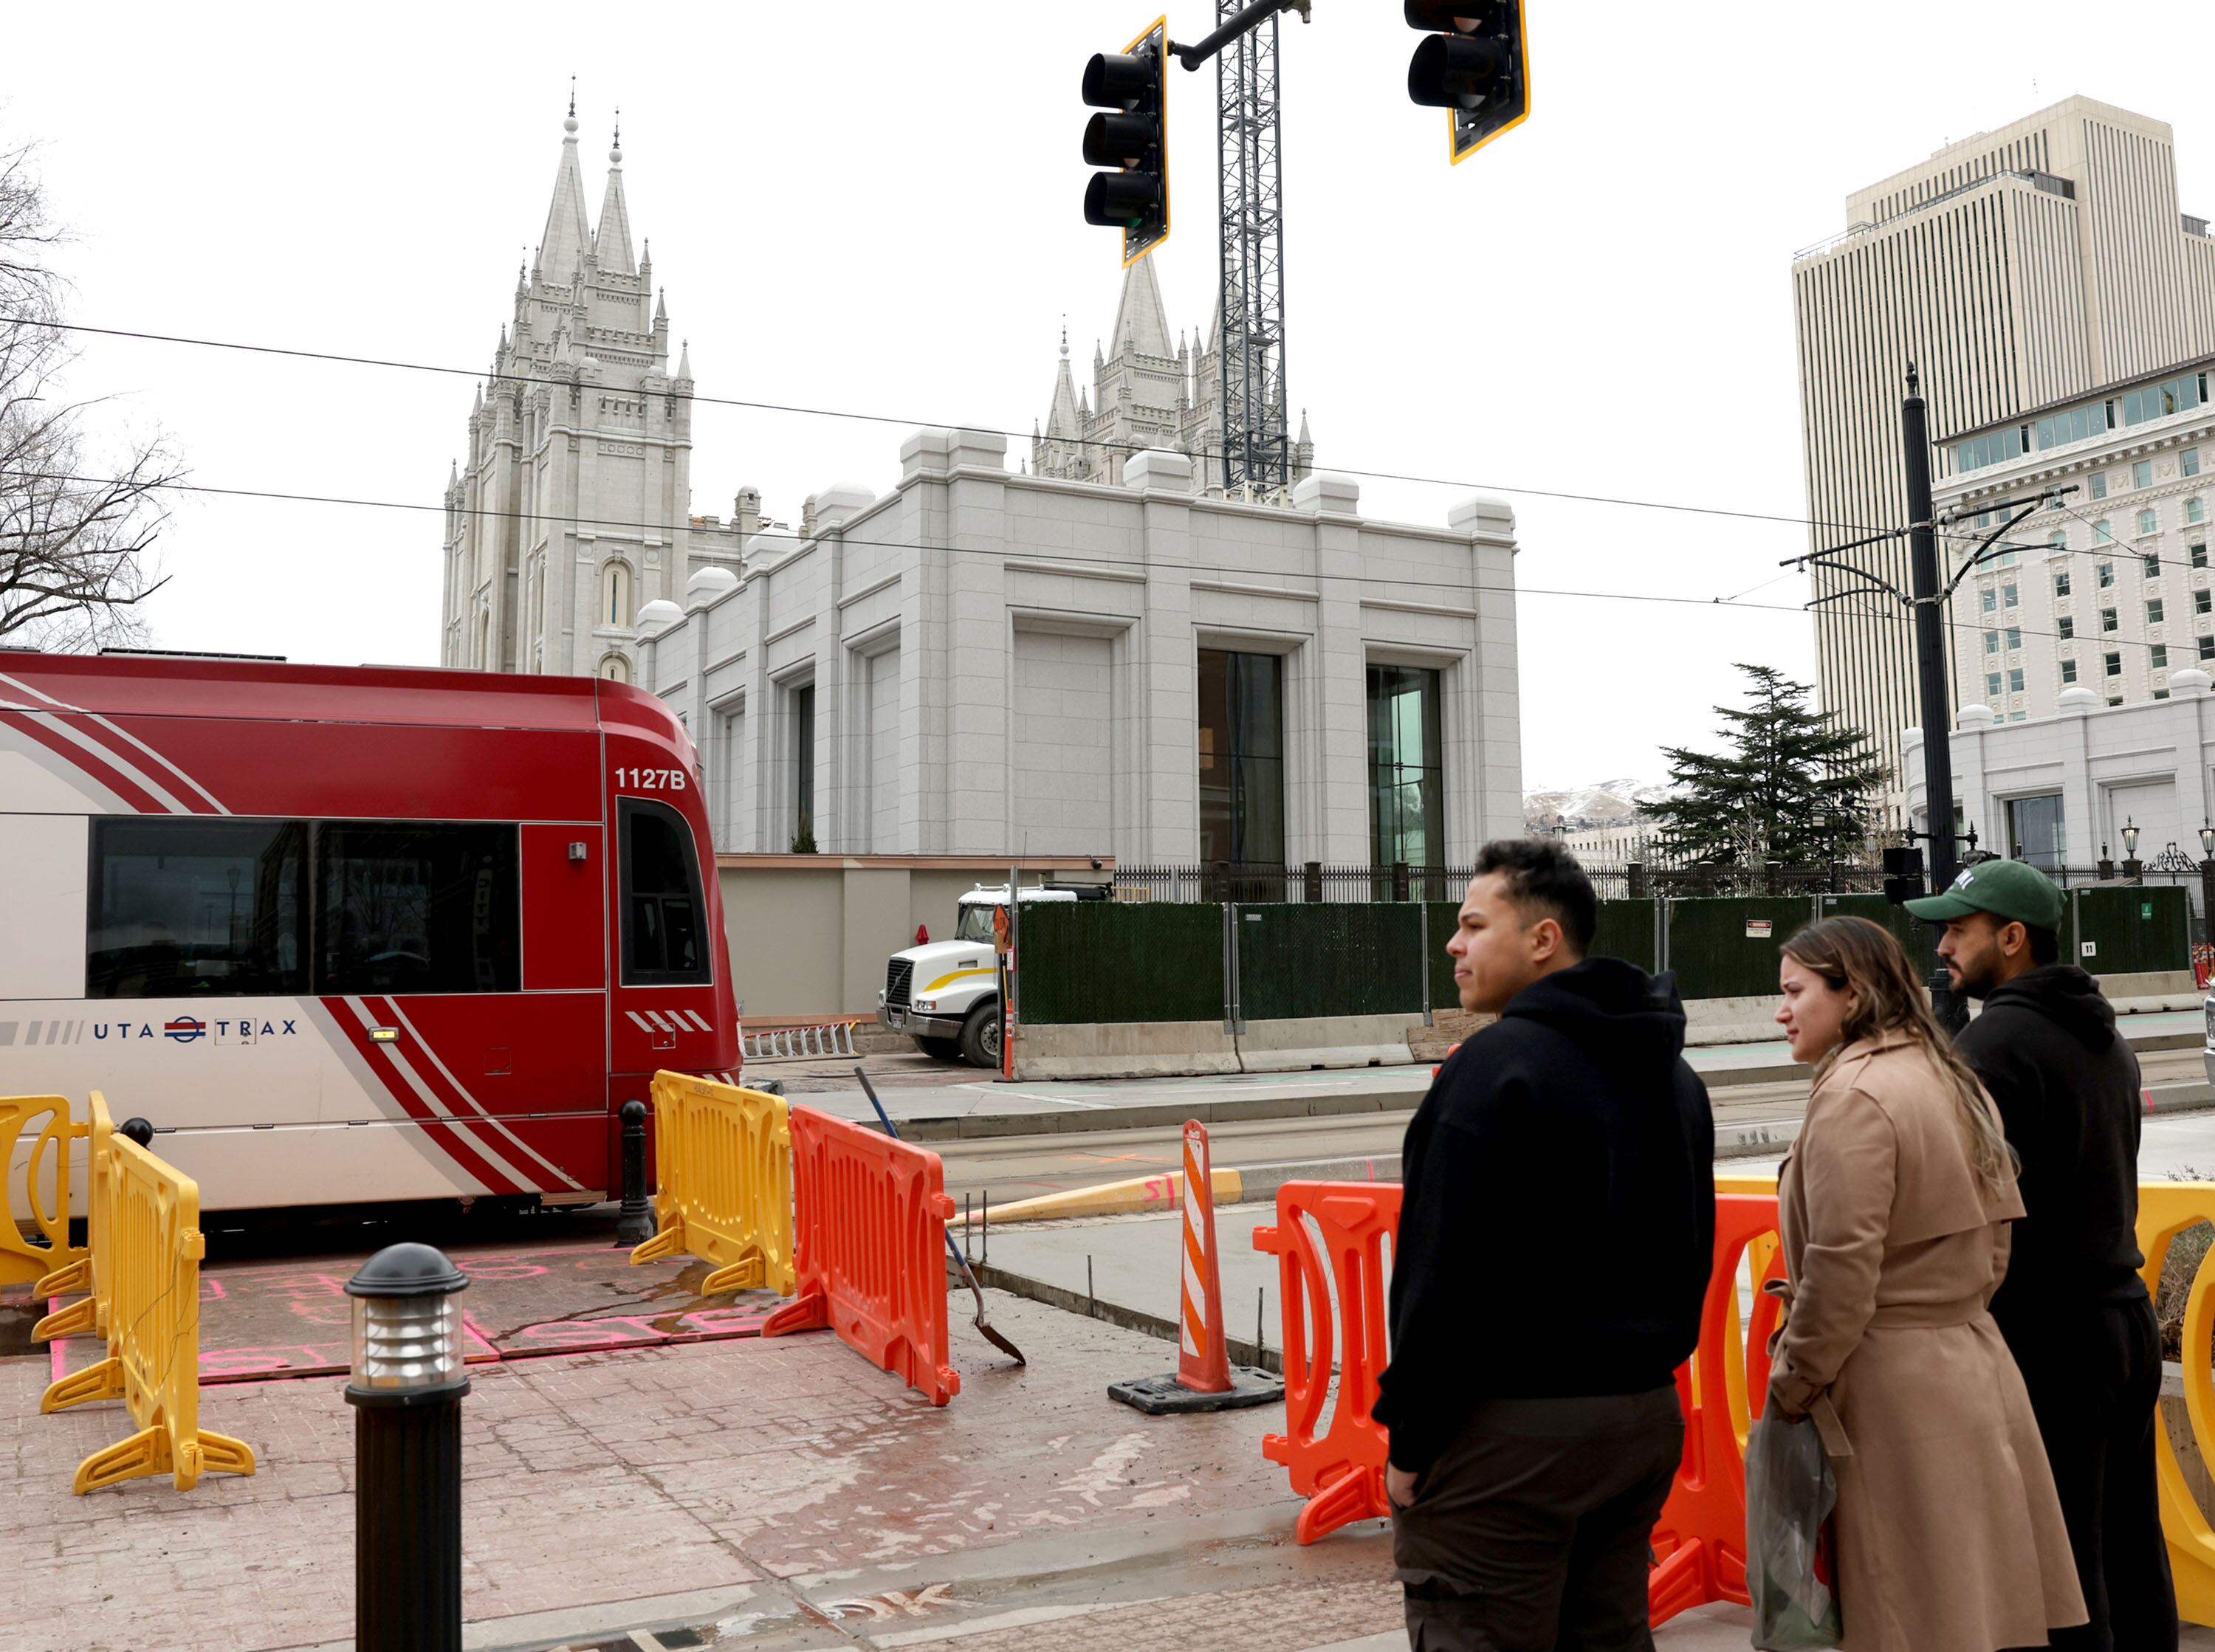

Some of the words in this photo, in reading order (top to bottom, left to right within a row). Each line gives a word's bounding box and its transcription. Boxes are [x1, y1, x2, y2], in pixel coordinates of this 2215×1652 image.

[615, 768, 686, 790] 1127B
[2086, 945, 2092, 953] 11
[95, 1023, 154, 1039] UTA
[216, 1020, 296, 1036] TRAX
